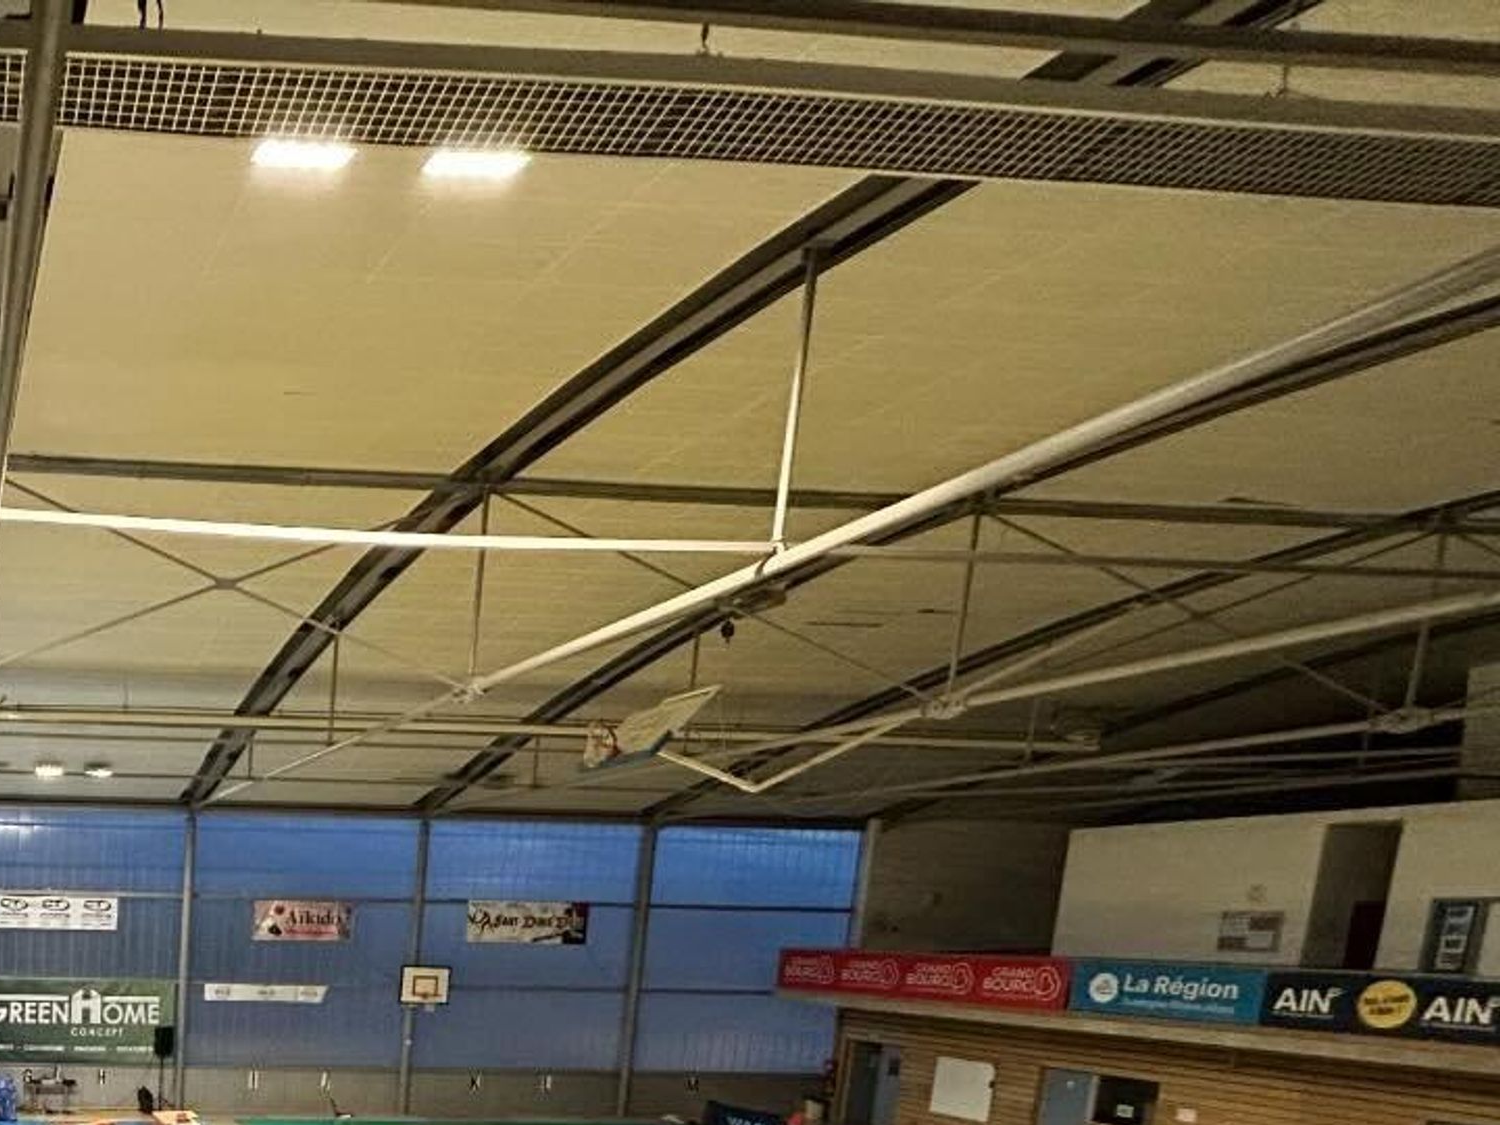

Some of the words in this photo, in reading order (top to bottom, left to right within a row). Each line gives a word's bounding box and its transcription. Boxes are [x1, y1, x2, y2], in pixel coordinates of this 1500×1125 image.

[1123, 973, 1149, 993] La
[1153, 975, 1239, 1000] Région
[1273, 987, 1333, 1014] AIN
[1423, 996, 1494, 1025] AIN
[70, 1026, 124, 1037] CONCEPT
